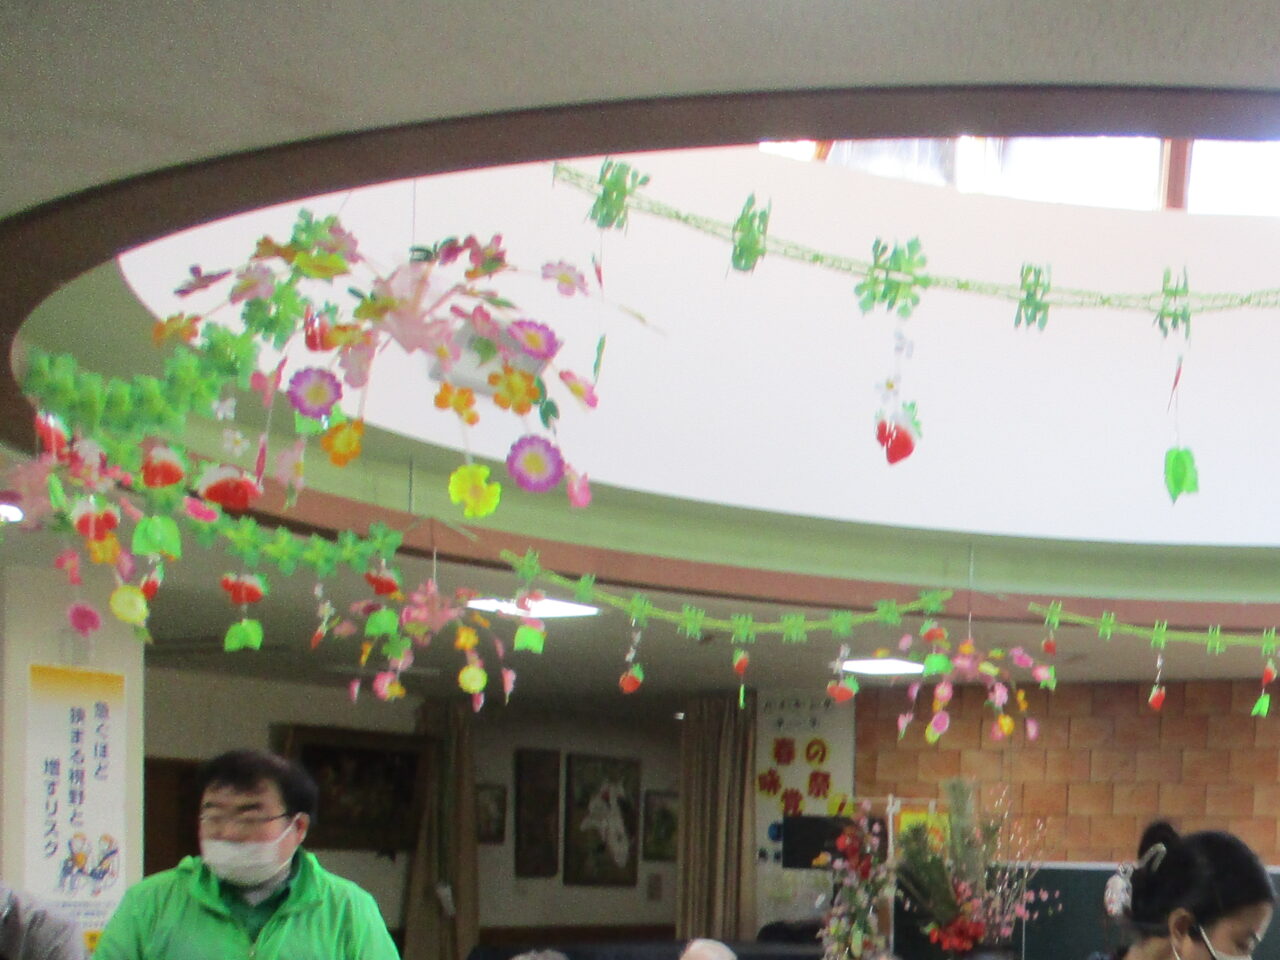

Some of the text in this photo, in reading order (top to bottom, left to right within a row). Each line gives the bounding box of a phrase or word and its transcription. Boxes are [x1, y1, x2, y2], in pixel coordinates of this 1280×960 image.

[43, 757, 61, 859] 増すリスク
